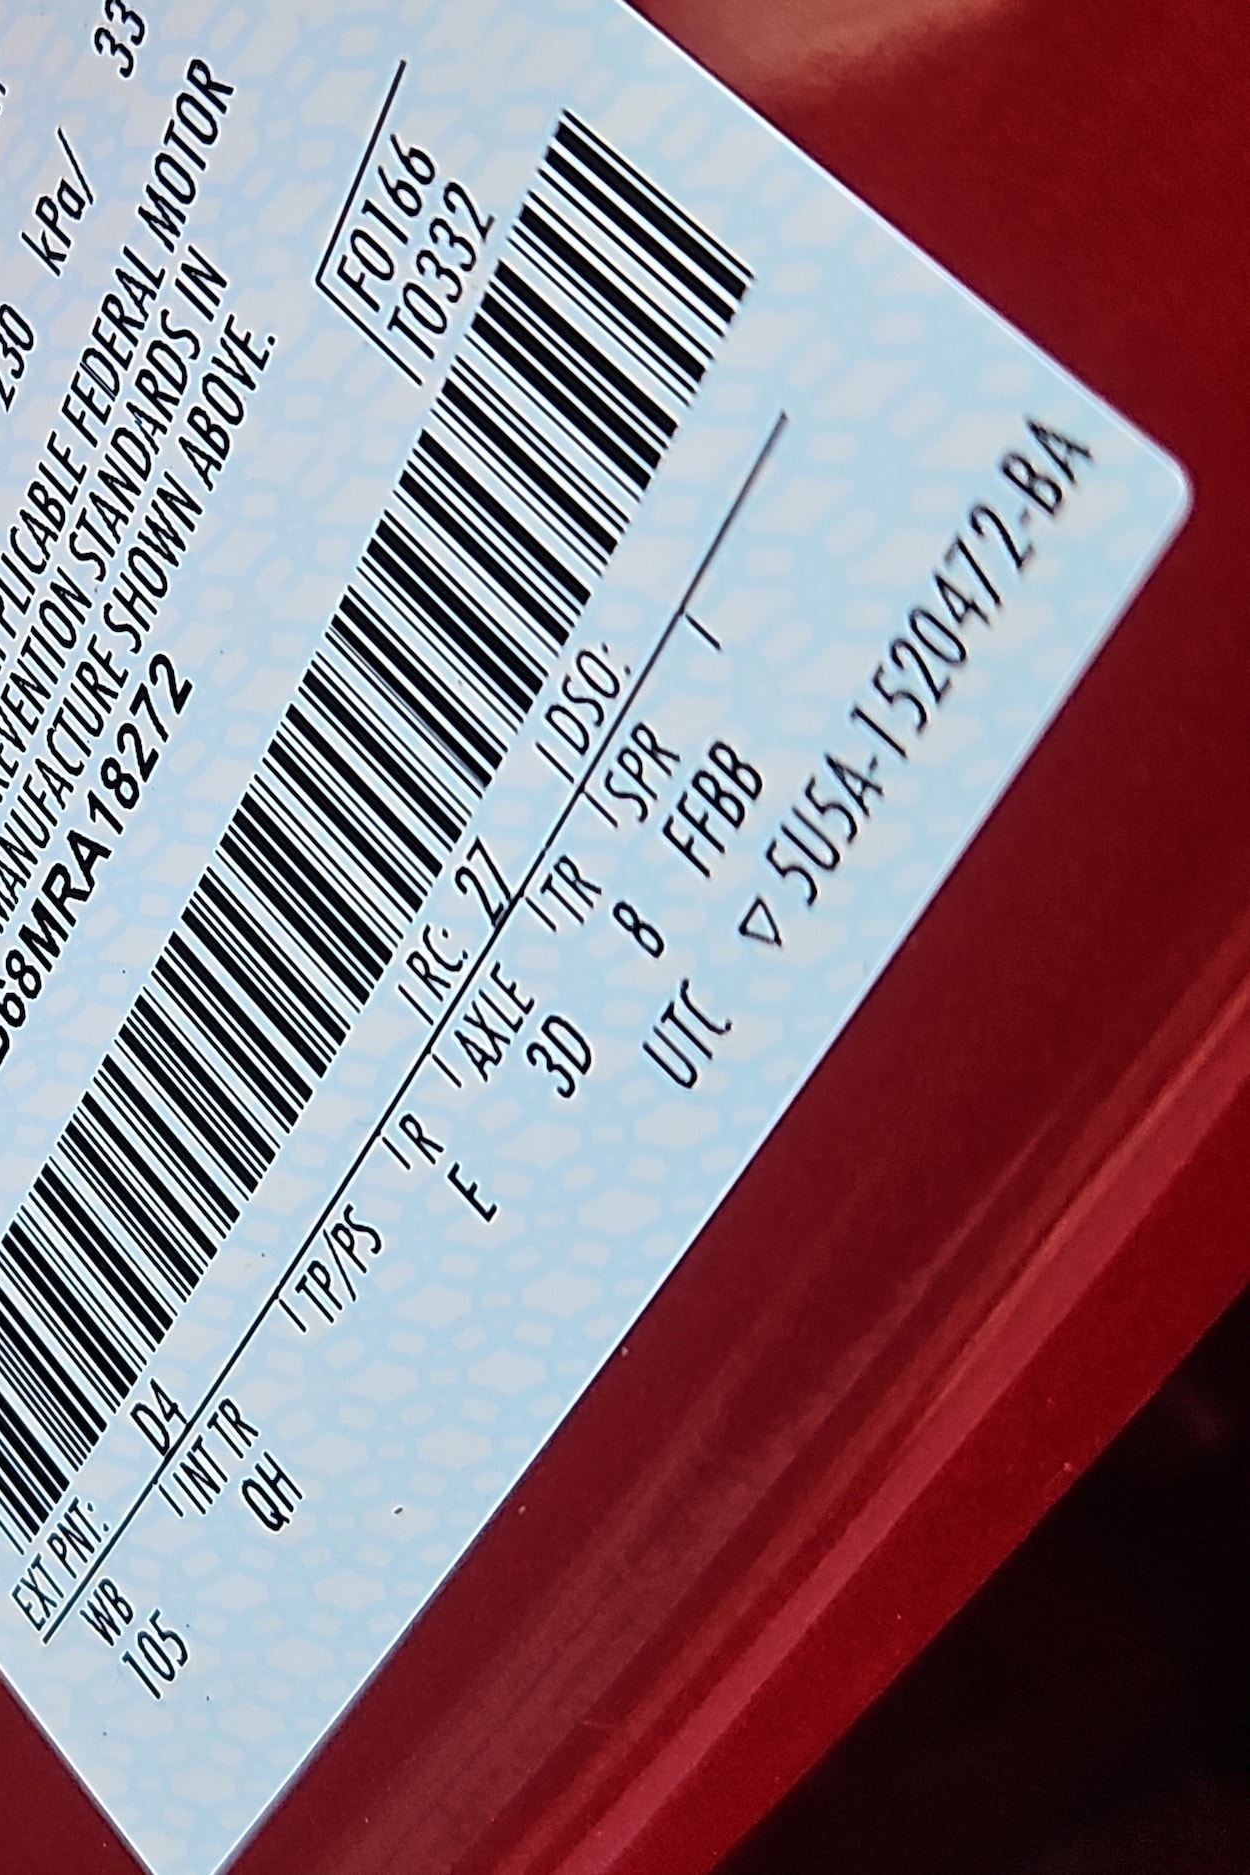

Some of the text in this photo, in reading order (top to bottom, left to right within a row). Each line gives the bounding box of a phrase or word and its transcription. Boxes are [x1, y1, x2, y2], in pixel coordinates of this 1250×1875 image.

[20, 126, 95, 278] kPa/
[93, 0, 146, 79] 33
[60, 245, 167, 449] FEDERAL
[137, 58, 235, 254] MOTOR
[68, 307, 202, 583] STANDARDS
[173, 244, 229, 323] IN
[102, 470, 204, 655] SHOWN
[177, 313, 277, 493] ABOVE.
[641, 418, 1093, 1090] UTC 5U5A-1520472-BA
[10, 642, 632, 1633] EXT PNT: D4 RC: 27 DSO:
[79, 720, 682, 1648] WB INT TR TP/PS R AXLE TR SPR
[121, 739, 764, 1701] 105 QH E 3D 8 FFBB
